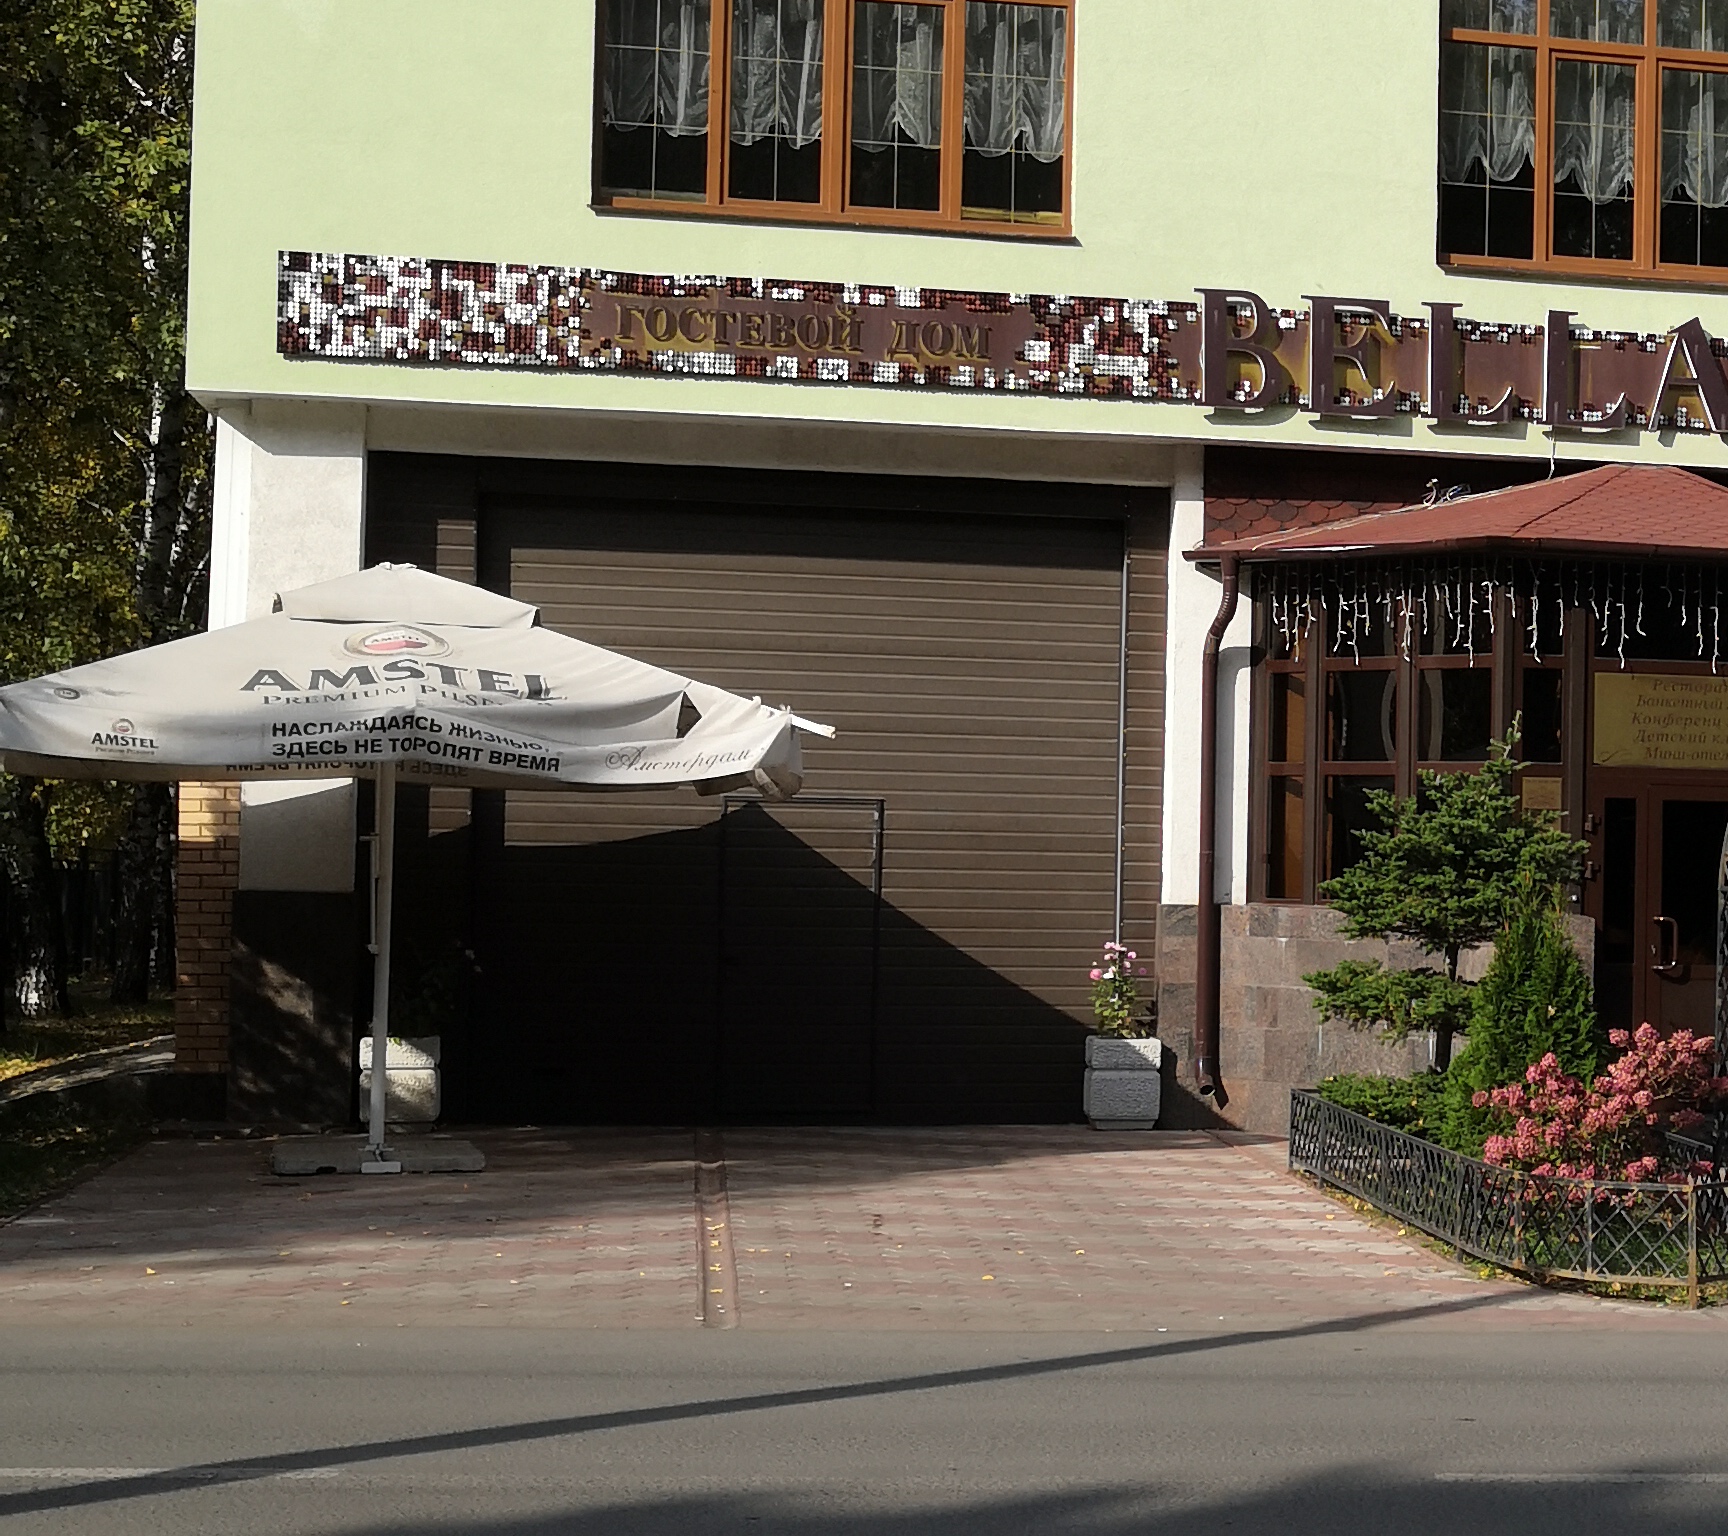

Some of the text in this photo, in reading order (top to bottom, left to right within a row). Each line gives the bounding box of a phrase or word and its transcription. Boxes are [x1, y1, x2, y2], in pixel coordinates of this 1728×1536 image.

[615, 303, 992, 362] ГОСТЕВОЙ ДОМ
[240, 659, 567, 700] AMSTEL
[262, 685, 406, 705] PREMIUM
[1637, 695, 1723, 710] Банкетный
[272, 715, 443, 737] НАСЛАЖДАЯСЬ
[1631, 713, 1722, 730] Конференц
[92, 732, 159, 749] AMSTEL
[1633, 730, 1707, 744] Детский
[272, 737, 560, 772] ЗДЕСЬ НЕ ТОРОПЯТ ВРЕМЯ
